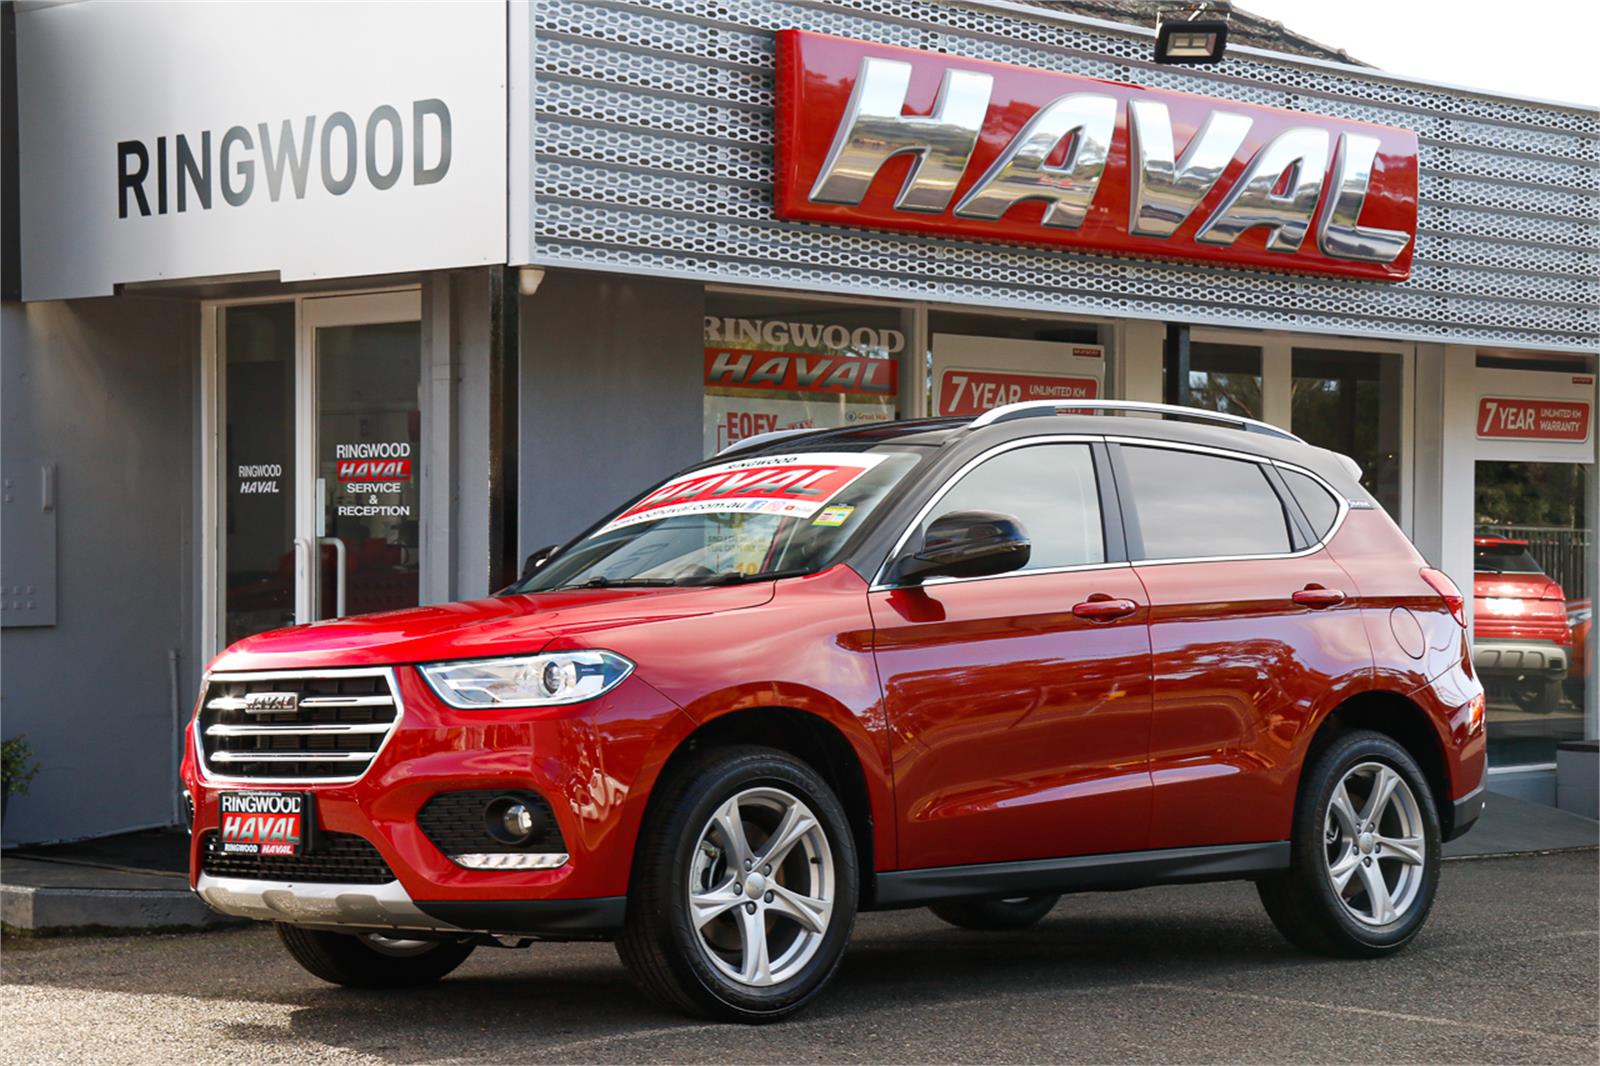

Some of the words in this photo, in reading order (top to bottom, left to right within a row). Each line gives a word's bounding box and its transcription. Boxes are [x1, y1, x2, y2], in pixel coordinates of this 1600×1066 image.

[116, 97, 453, 219] RINGWOOD
[808, 55, 1410, 264] HAVAL
[704, 316, 905, 353] RINGWOOD
[709, 352, 891, 391] HAVAL
[948, 376, 968, 412] 7
[971, 382, 1022, 409] YEAR
[1029, 385, 1072, 397] UNLIMITED
[1072, 388, 1087, 398] KM
[1483, 402, 1498, 433] 7
[1499, 407, 1536, 431] YEAR
[1540, 408, 1572, 418] UNLIMITED
[1540, 420, 1581, 432] WARRANTY
[336, 442, 411, 458] RINGWOOD
[238, 464, 282, 478] RINGWOOD
[339, 461, 409, 479] HAVAL
[240, 481, 280, 494] HAVAL
[346, 482, 401, 493] SERVICE
[369, 494, 379, 505] &
[338, 505, 411, 516] RECEPTION
[222, 795, 301, 814] RINGWOOD
[223, 816, 300, 842] HAVAL
[224, 843, 259, 853] RINGWOOD
[262, 845, 294, 855] HAVAL
